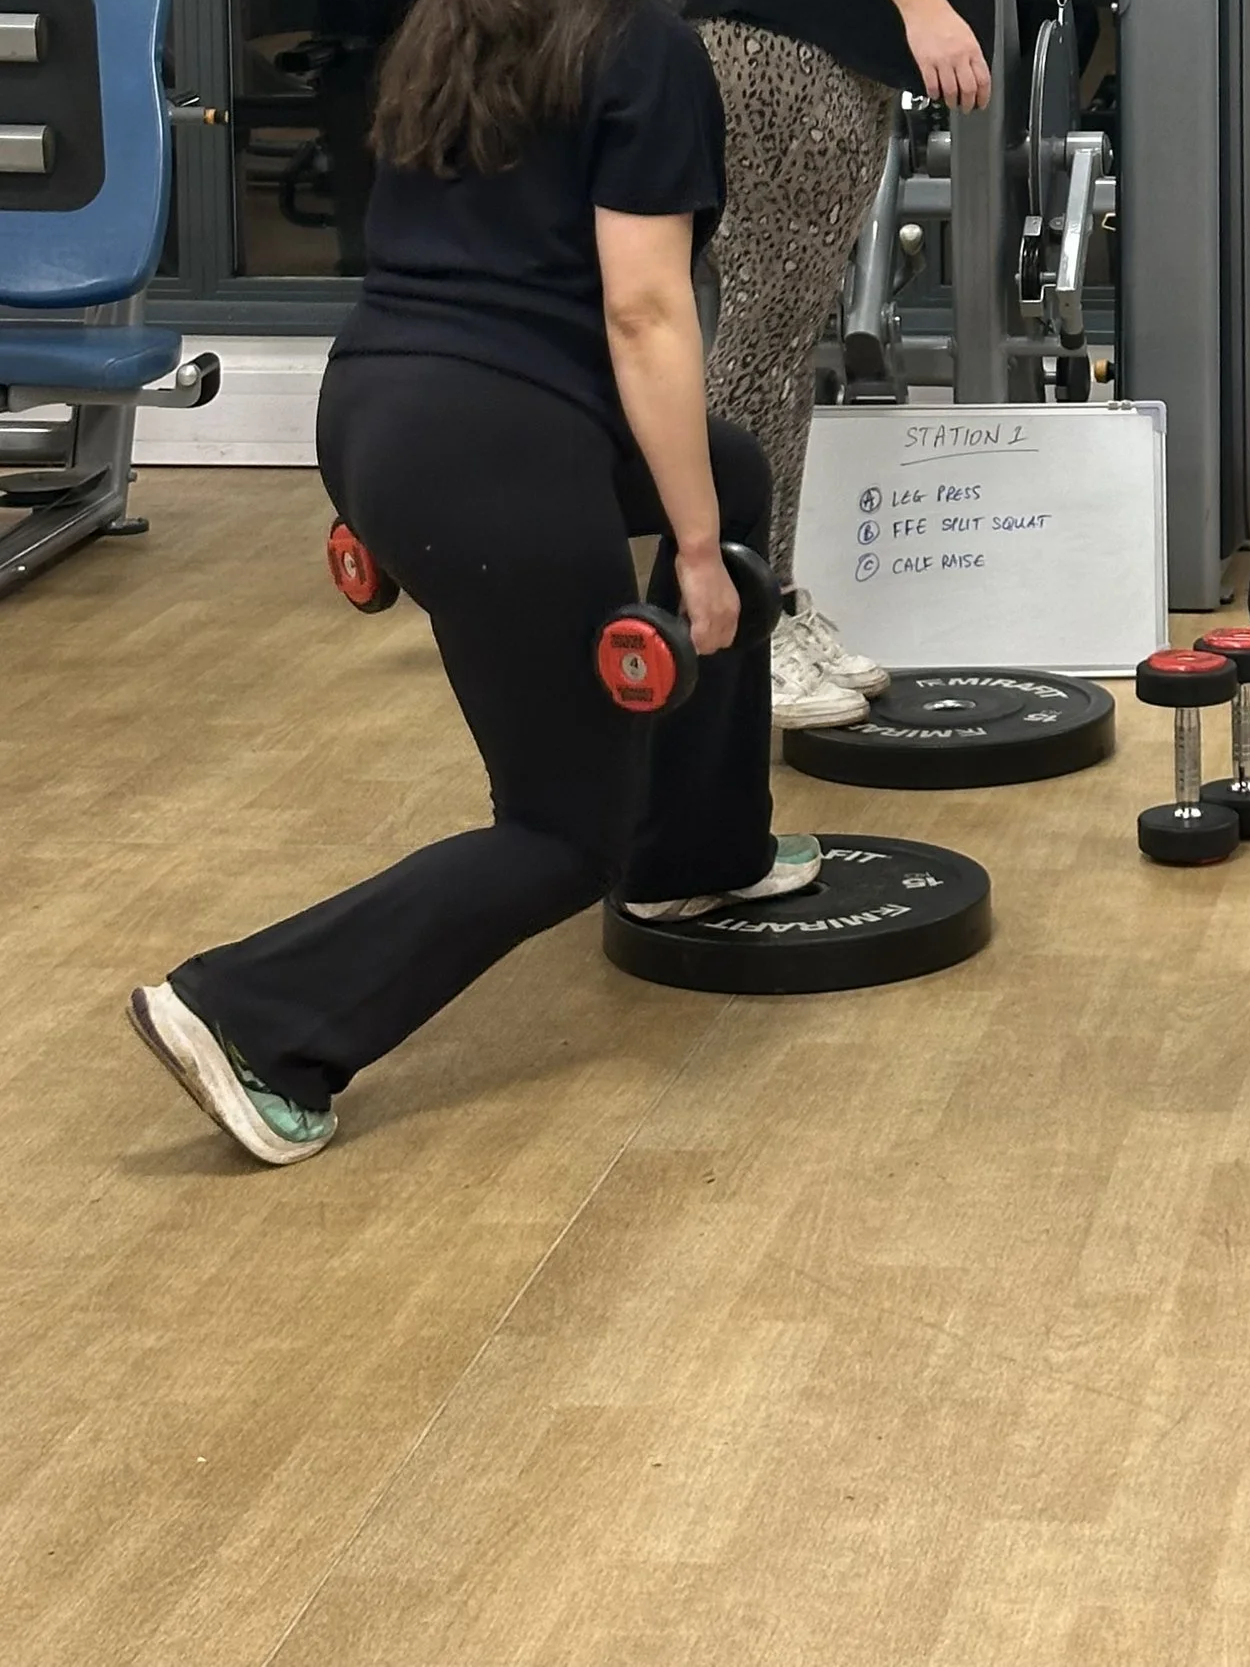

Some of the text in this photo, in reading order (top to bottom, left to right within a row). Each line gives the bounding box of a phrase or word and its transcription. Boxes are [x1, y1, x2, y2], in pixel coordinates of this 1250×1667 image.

[904, 423, 1029, 448] STATION 1
[891, 489, 927, 508] LEG
[937, 485, 982, 503] PRESS
[892, 518, 928, 538] FFE
[941, 516, 986, 533] SPLIT
[991, 514, 1053, 532] SQUAT
[891, 556, 933, 575] CALF
[941, 553, 986, 570] RAISE
[630, 657, 639, 669] 4
[948, 676, 1070, 700] MIRAFIT
[702, 907, 883, 933] MIRAFIT
